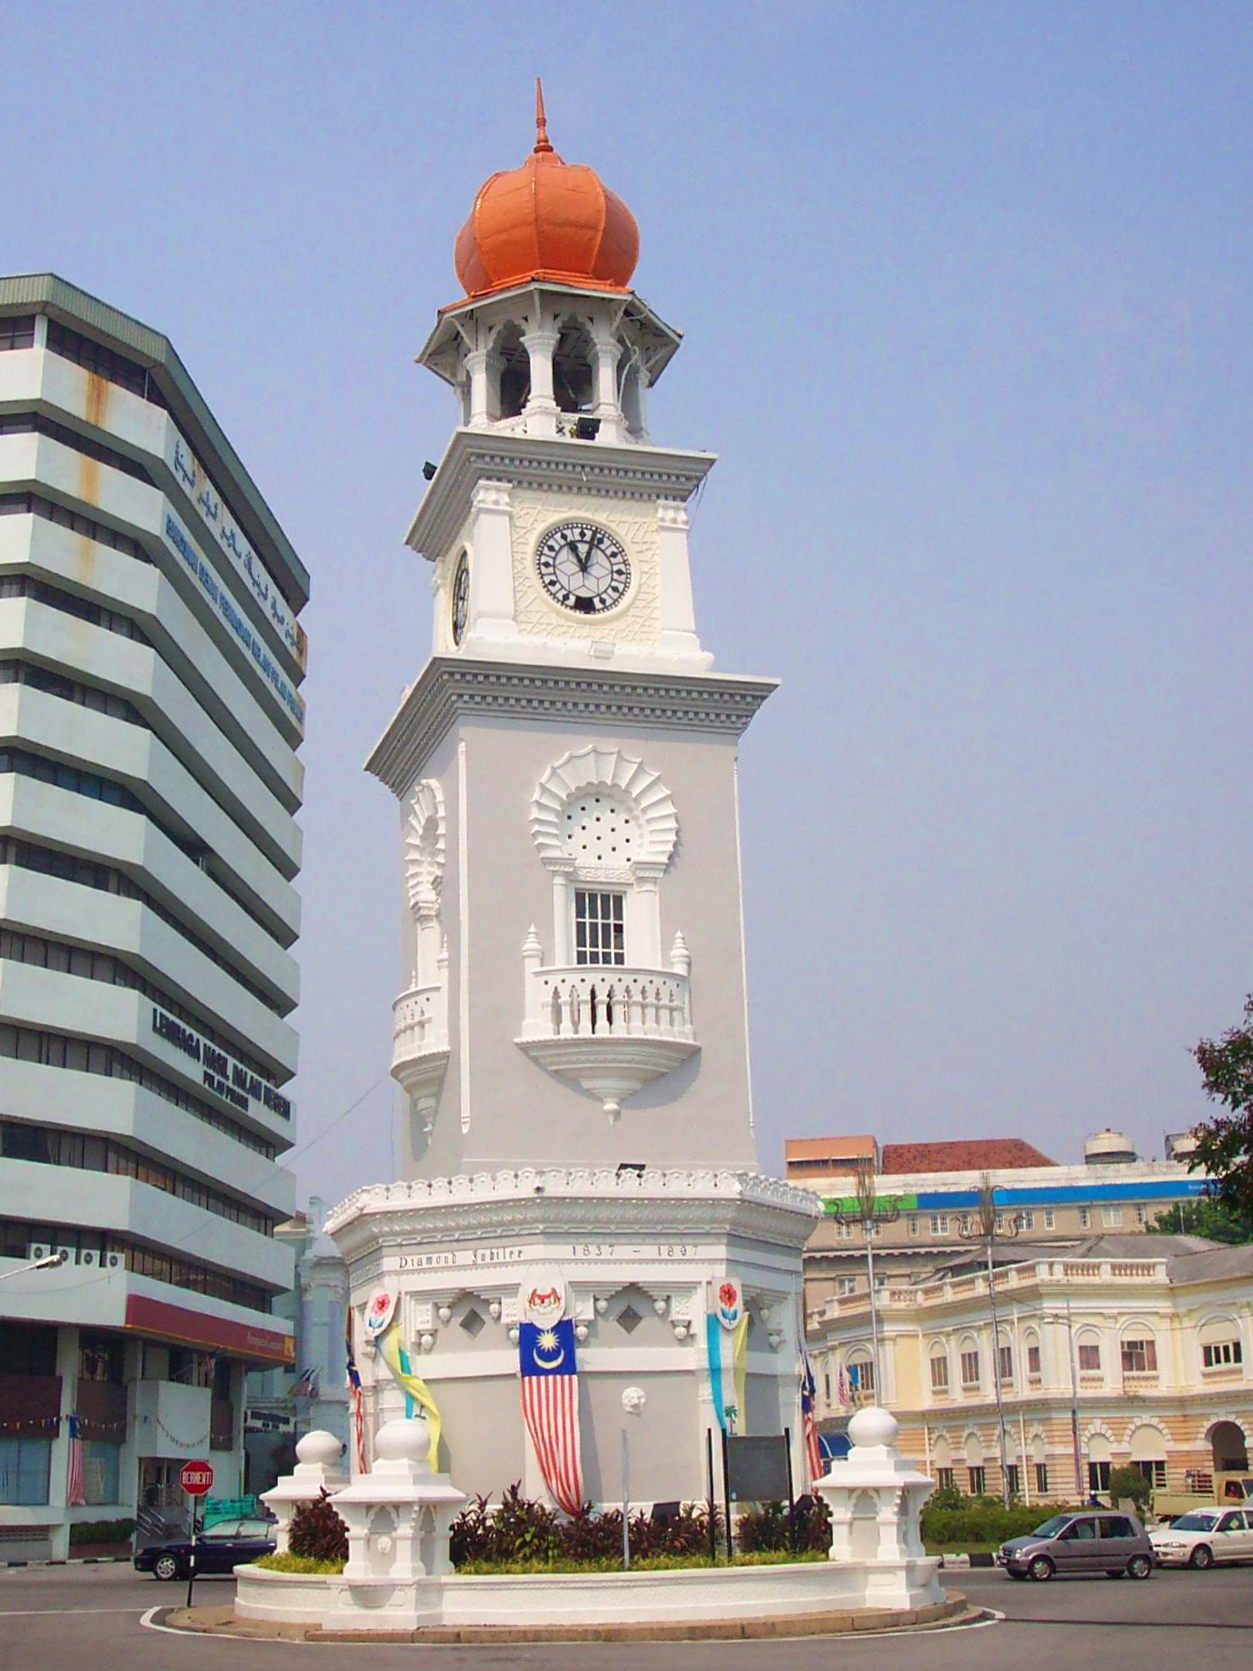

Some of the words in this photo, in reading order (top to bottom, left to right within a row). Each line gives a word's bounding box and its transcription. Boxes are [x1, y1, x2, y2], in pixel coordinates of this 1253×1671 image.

[152, 1007, 201, 1062] LEMBAGA
[399, 1251, 457, 1269] Diamond
[472, 1247, 523, 1265] Jubilee
[572, 1244, 615, 1257] 1837
[657, 1244, 699, 1257] 1897
[182, 1471, 212, 1485] BERHENTI
